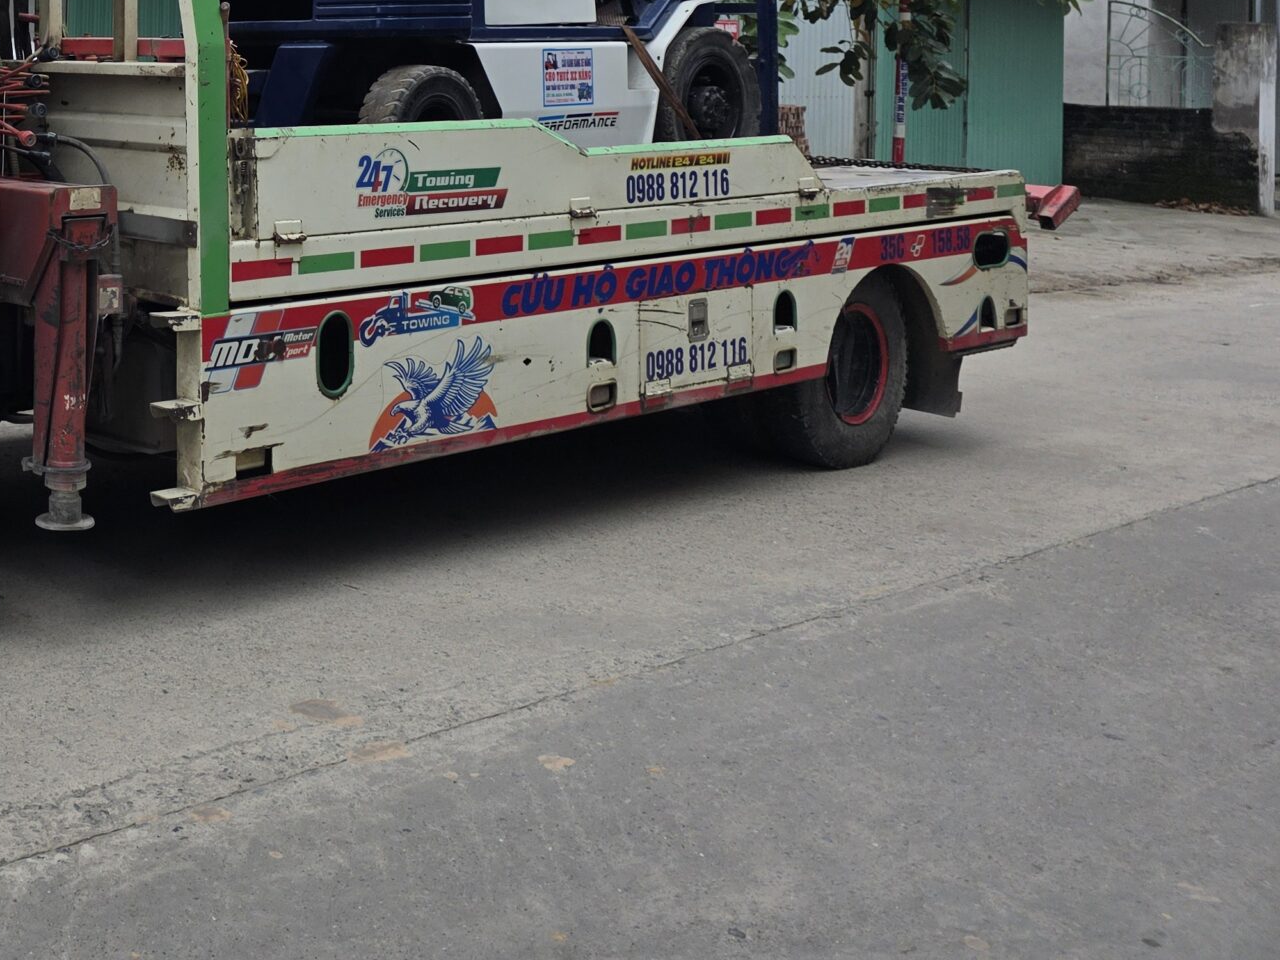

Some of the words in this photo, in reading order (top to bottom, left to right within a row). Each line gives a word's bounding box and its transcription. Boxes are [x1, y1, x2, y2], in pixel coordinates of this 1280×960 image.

[631, 156, 673, 171] HOTLINE
[414, 172, 475, 188] Towing
[626, 172, 665, 204] 0988
[670, 170, 698, 200] 812
[703, 168, 730, 197] 116
[357, 192, 410, 208] Emergency
[414, 194, 497, 210] Recovery
[374, 207, 405, 219] Services
[880, 233, 905, 261] 35C
[931, 226, 971, 254] 158.58
[502, 272, 565, 317] CỨU
[572, 263, 617, 314] HỘ
[625, 261, 696, 297] GIAO
[704, 245, 794, 290] THÔNG
[402, 314, 451, 331] TOWING
[283, 331, 314, 343] Motor
[284, 344, 308, 359] port
[646, 345, 685, 383] 0988
[689, 340, 717, 375] 812
[721, 335, 748, 367] 116
